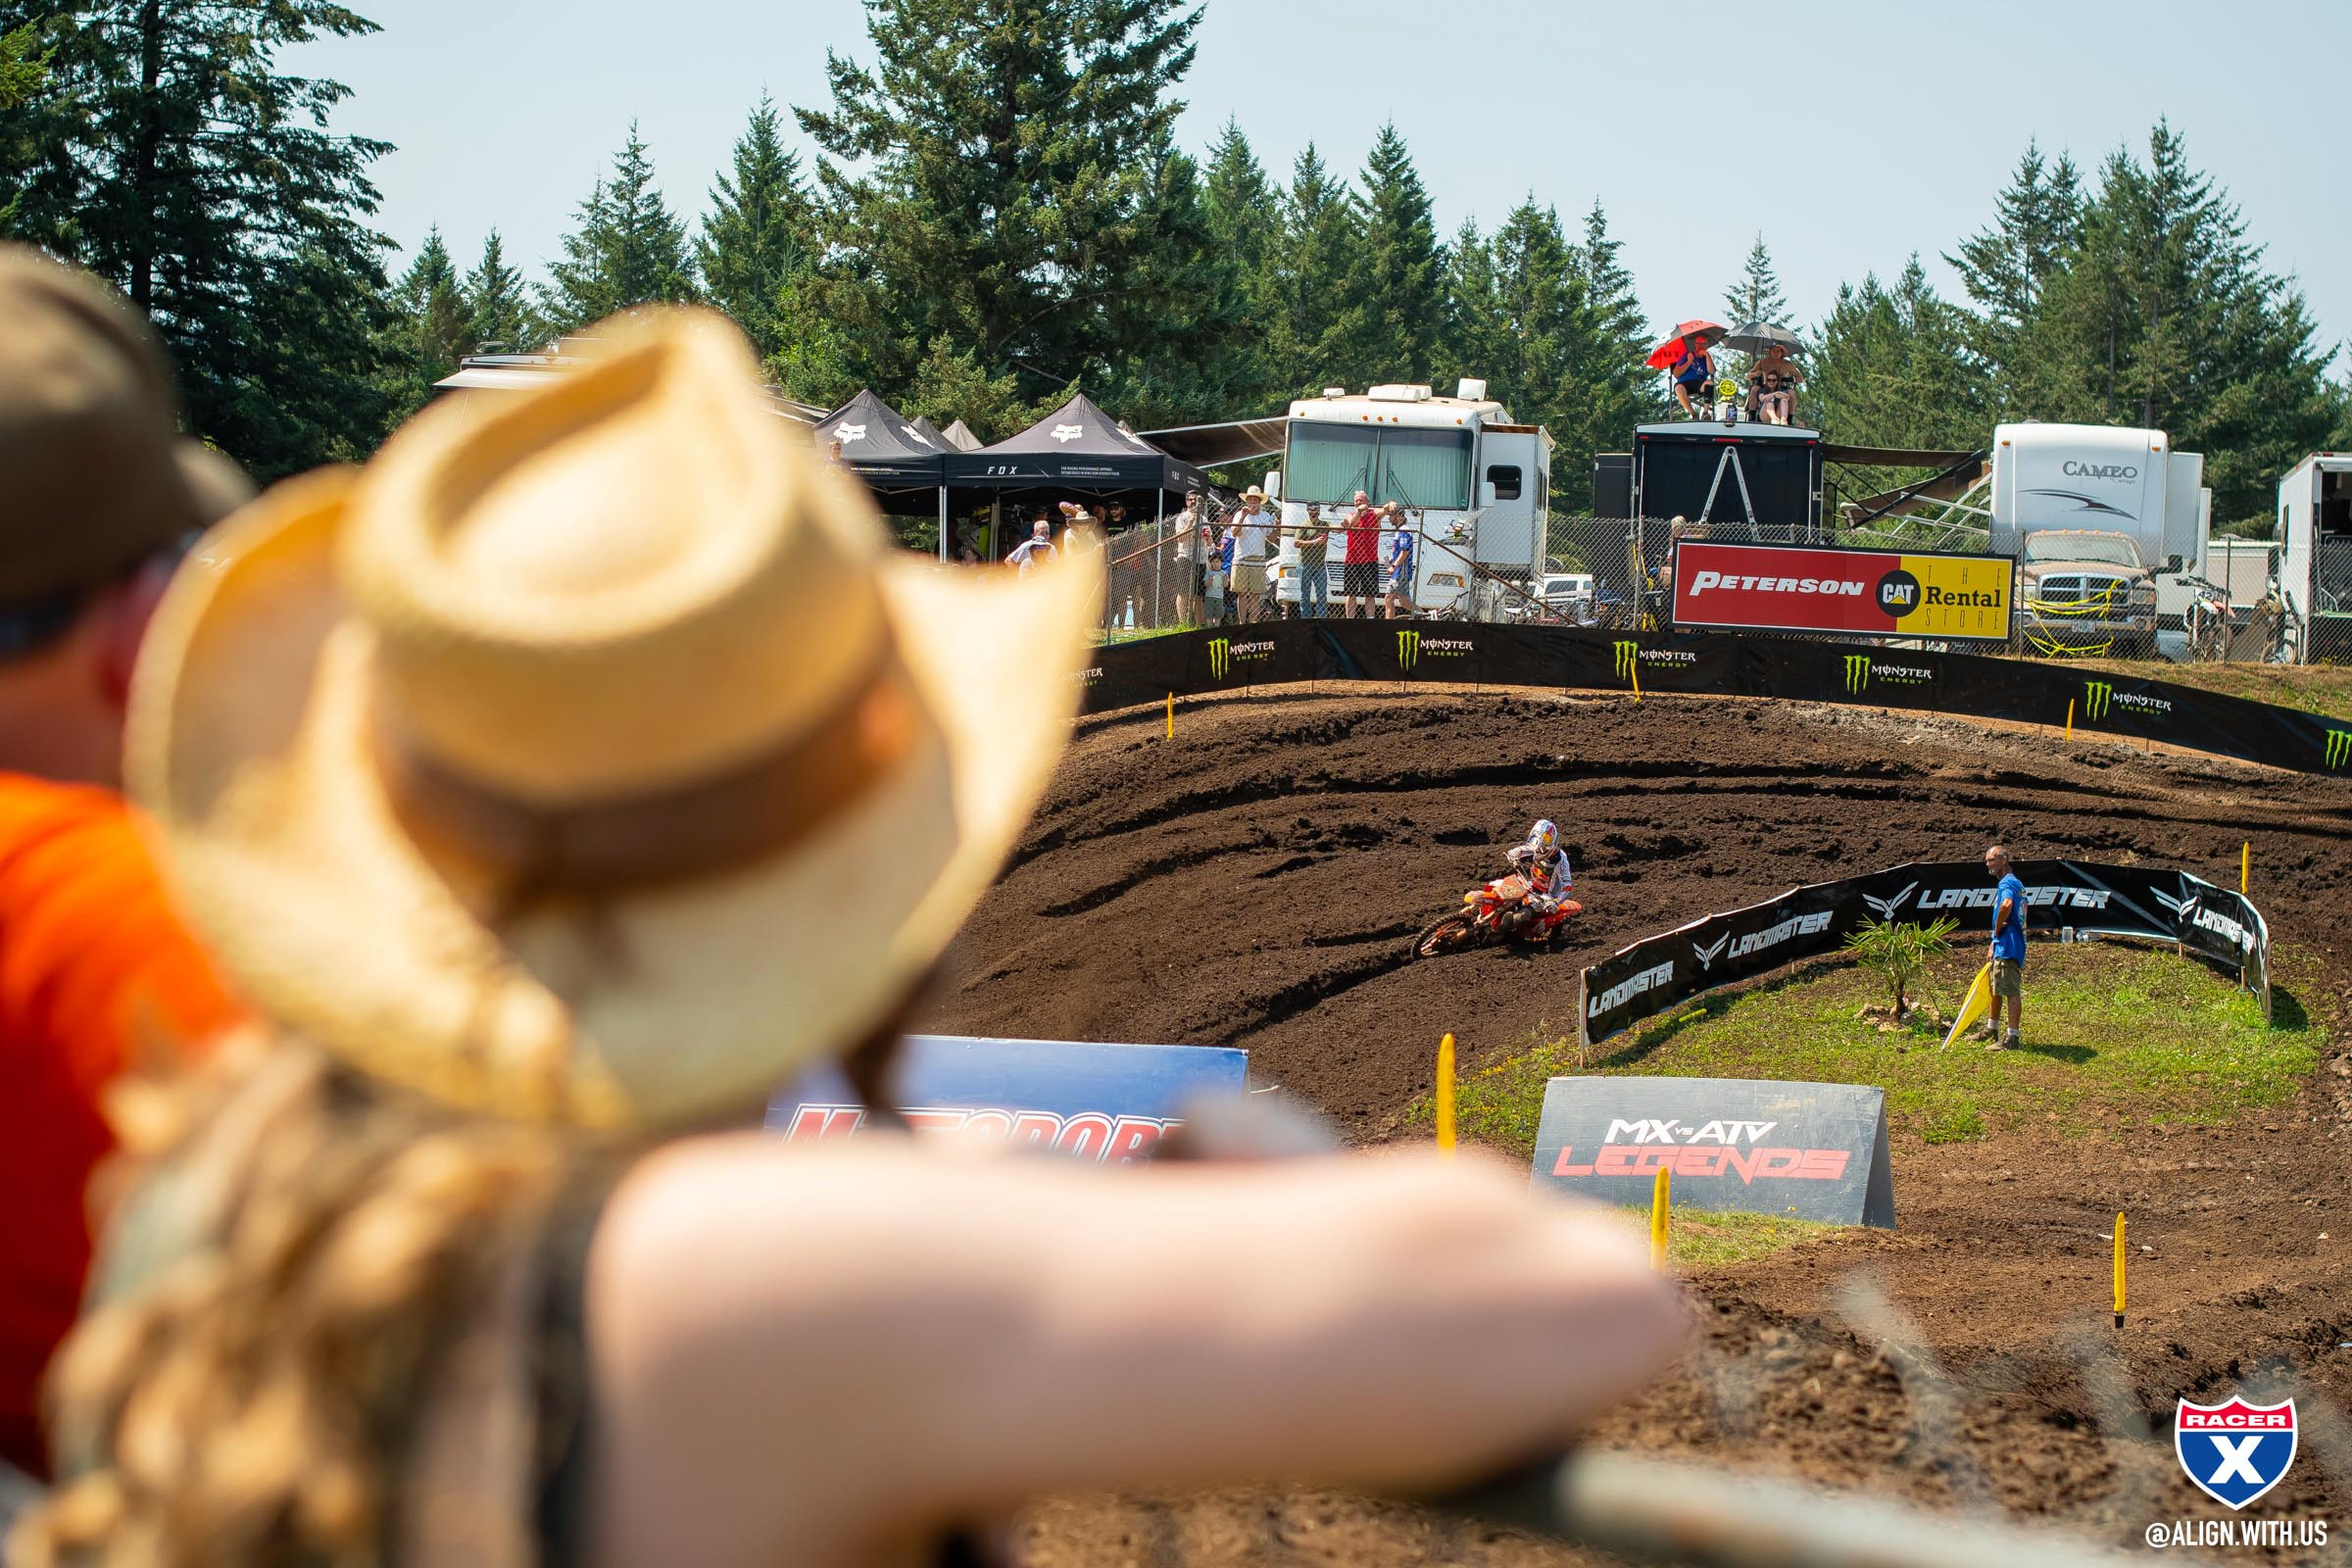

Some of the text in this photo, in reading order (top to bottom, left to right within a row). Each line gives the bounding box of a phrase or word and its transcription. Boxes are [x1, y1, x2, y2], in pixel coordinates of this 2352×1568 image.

[987, 466, 1018, 475] FOX
[2062, 461, 2138, 479] CAMEO
[1690, 570, 1865, 597] PETERSON
[1926, 564, 2002, 588] THE
[1883, 583, 1915, 605] CAT
[1925, 586, 2001, 608] Rental
[1925, 608, 1999, 630] STORE
[1229, 641, 1275, 656] MONSTER
[1419, 638, 1474, 651] MONSTER
[1639, 649, 1696, 662] MONSTER
[1871, 664, 1932, 679] MONSTER
[2113, 692, 2172, 711] MONSTER
[1917, 886, 2112, 909] LANDASTER
[1727, 910, 1834, 959] LANDMASTER
[1589, 960, 1674, 1018] LANDMASTER
[1604, 1119, 1681, 1144] MX
[1686, 1121, 1779, 1145] ATV
[1552, 1146, 1851, 1186] LEGENDS
